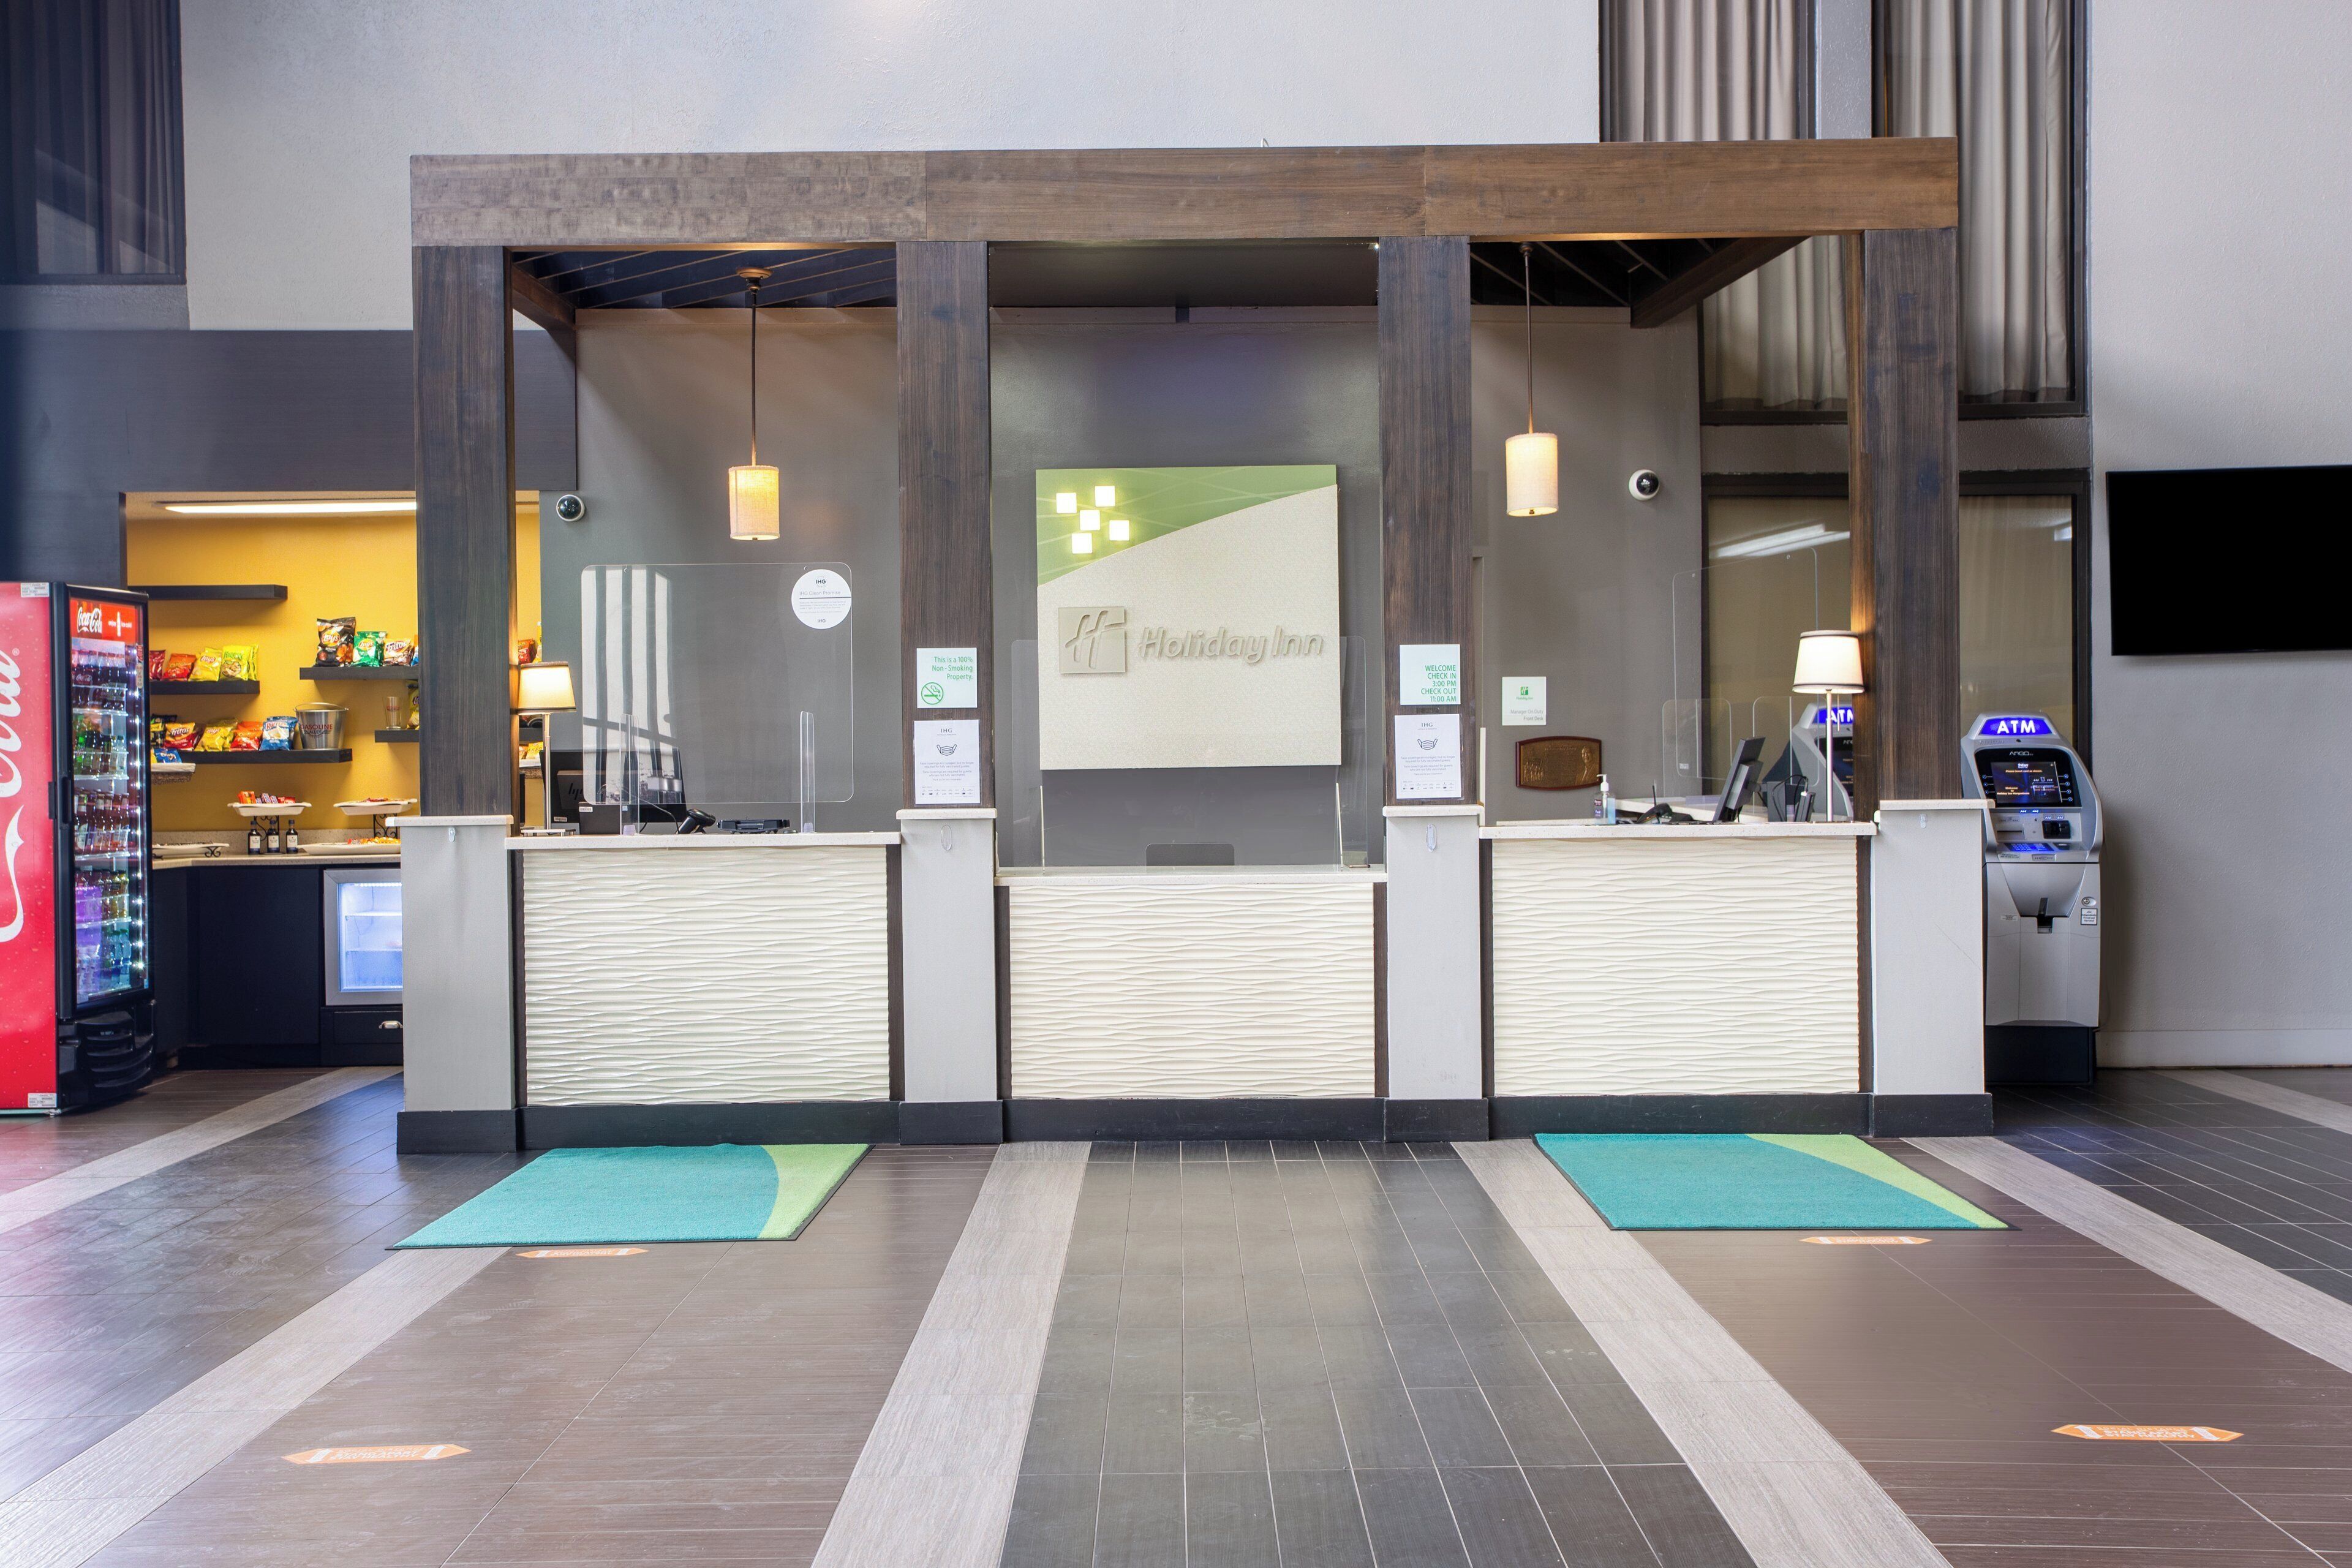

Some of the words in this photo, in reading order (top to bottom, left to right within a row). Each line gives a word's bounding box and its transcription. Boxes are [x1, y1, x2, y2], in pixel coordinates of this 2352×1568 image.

[1138, 627, 1265, 665] Holiday
[1272, 626, 1324, 656] Inn
[1997, 719, 2037, 734] ATM
